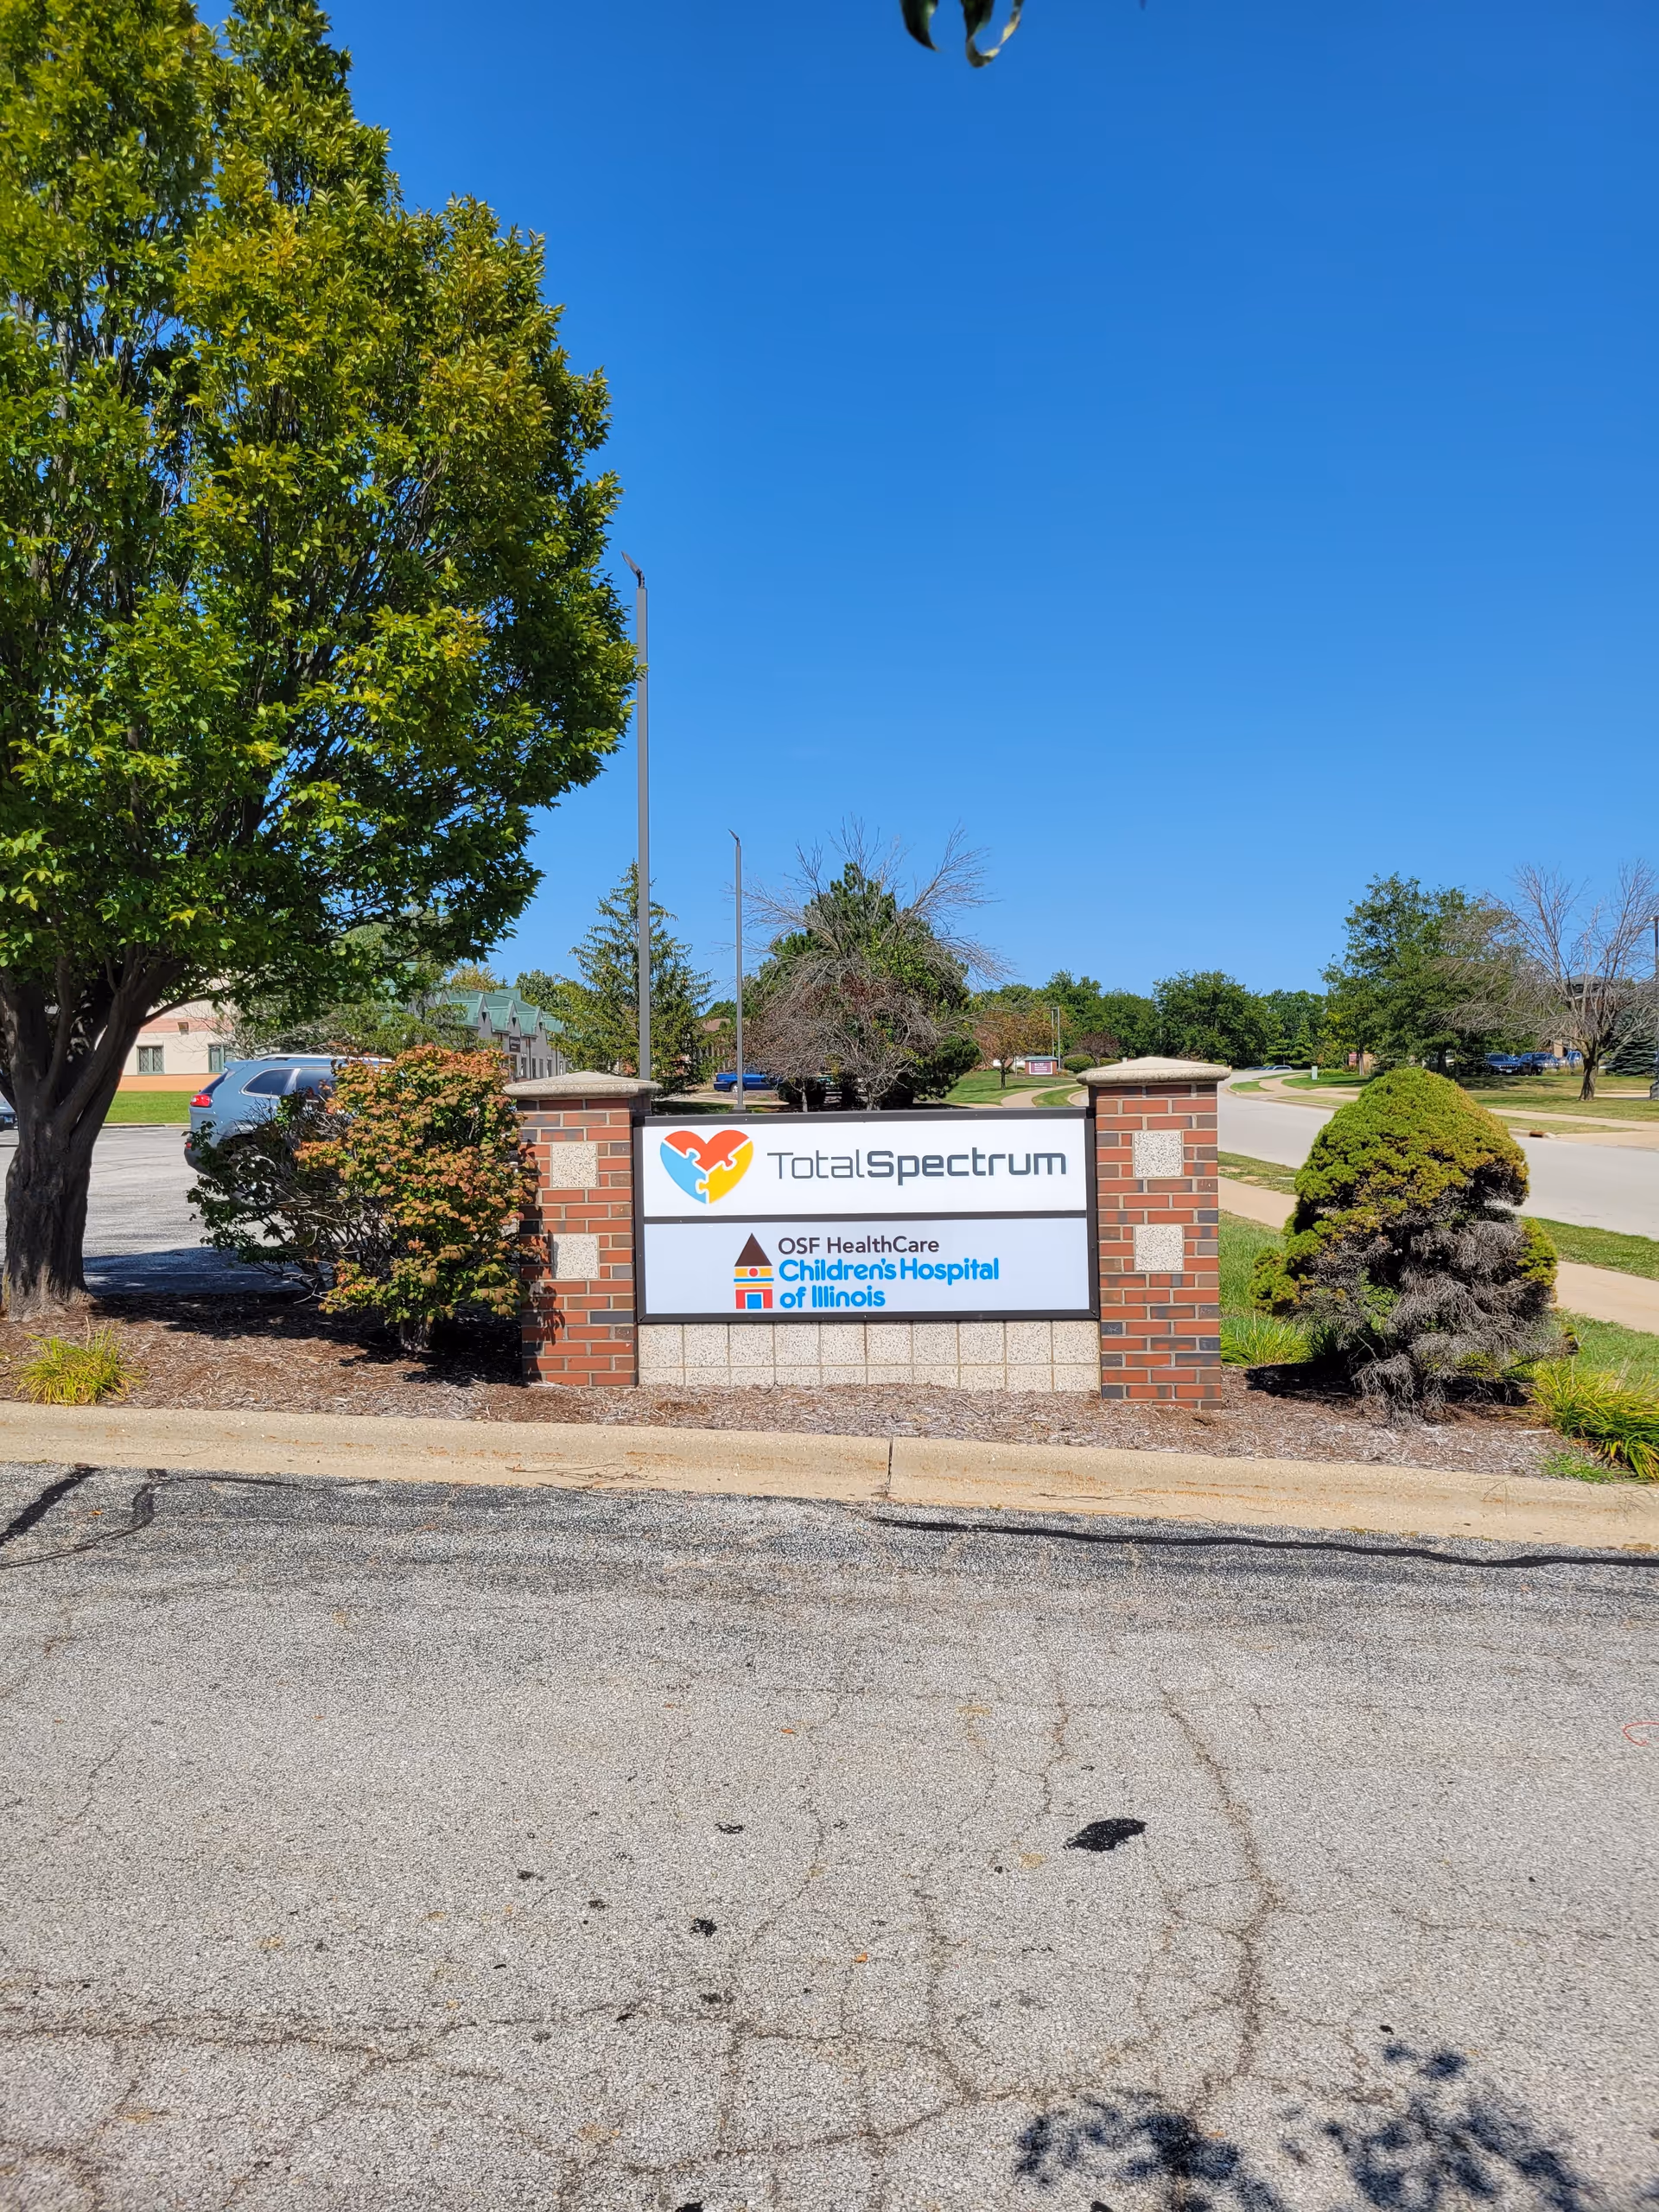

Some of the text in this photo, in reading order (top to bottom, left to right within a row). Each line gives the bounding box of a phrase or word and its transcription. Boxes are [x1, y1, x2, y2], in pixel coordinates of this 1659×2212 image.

[767, 1147, 1066, 1186] TotalSpectrum
[778, 1235, 940, 1255] OSF HealthCare
[779, 1257, 1000, 1286] Children's Hospital
[779, 1285, 886, 1309] of Illinois
